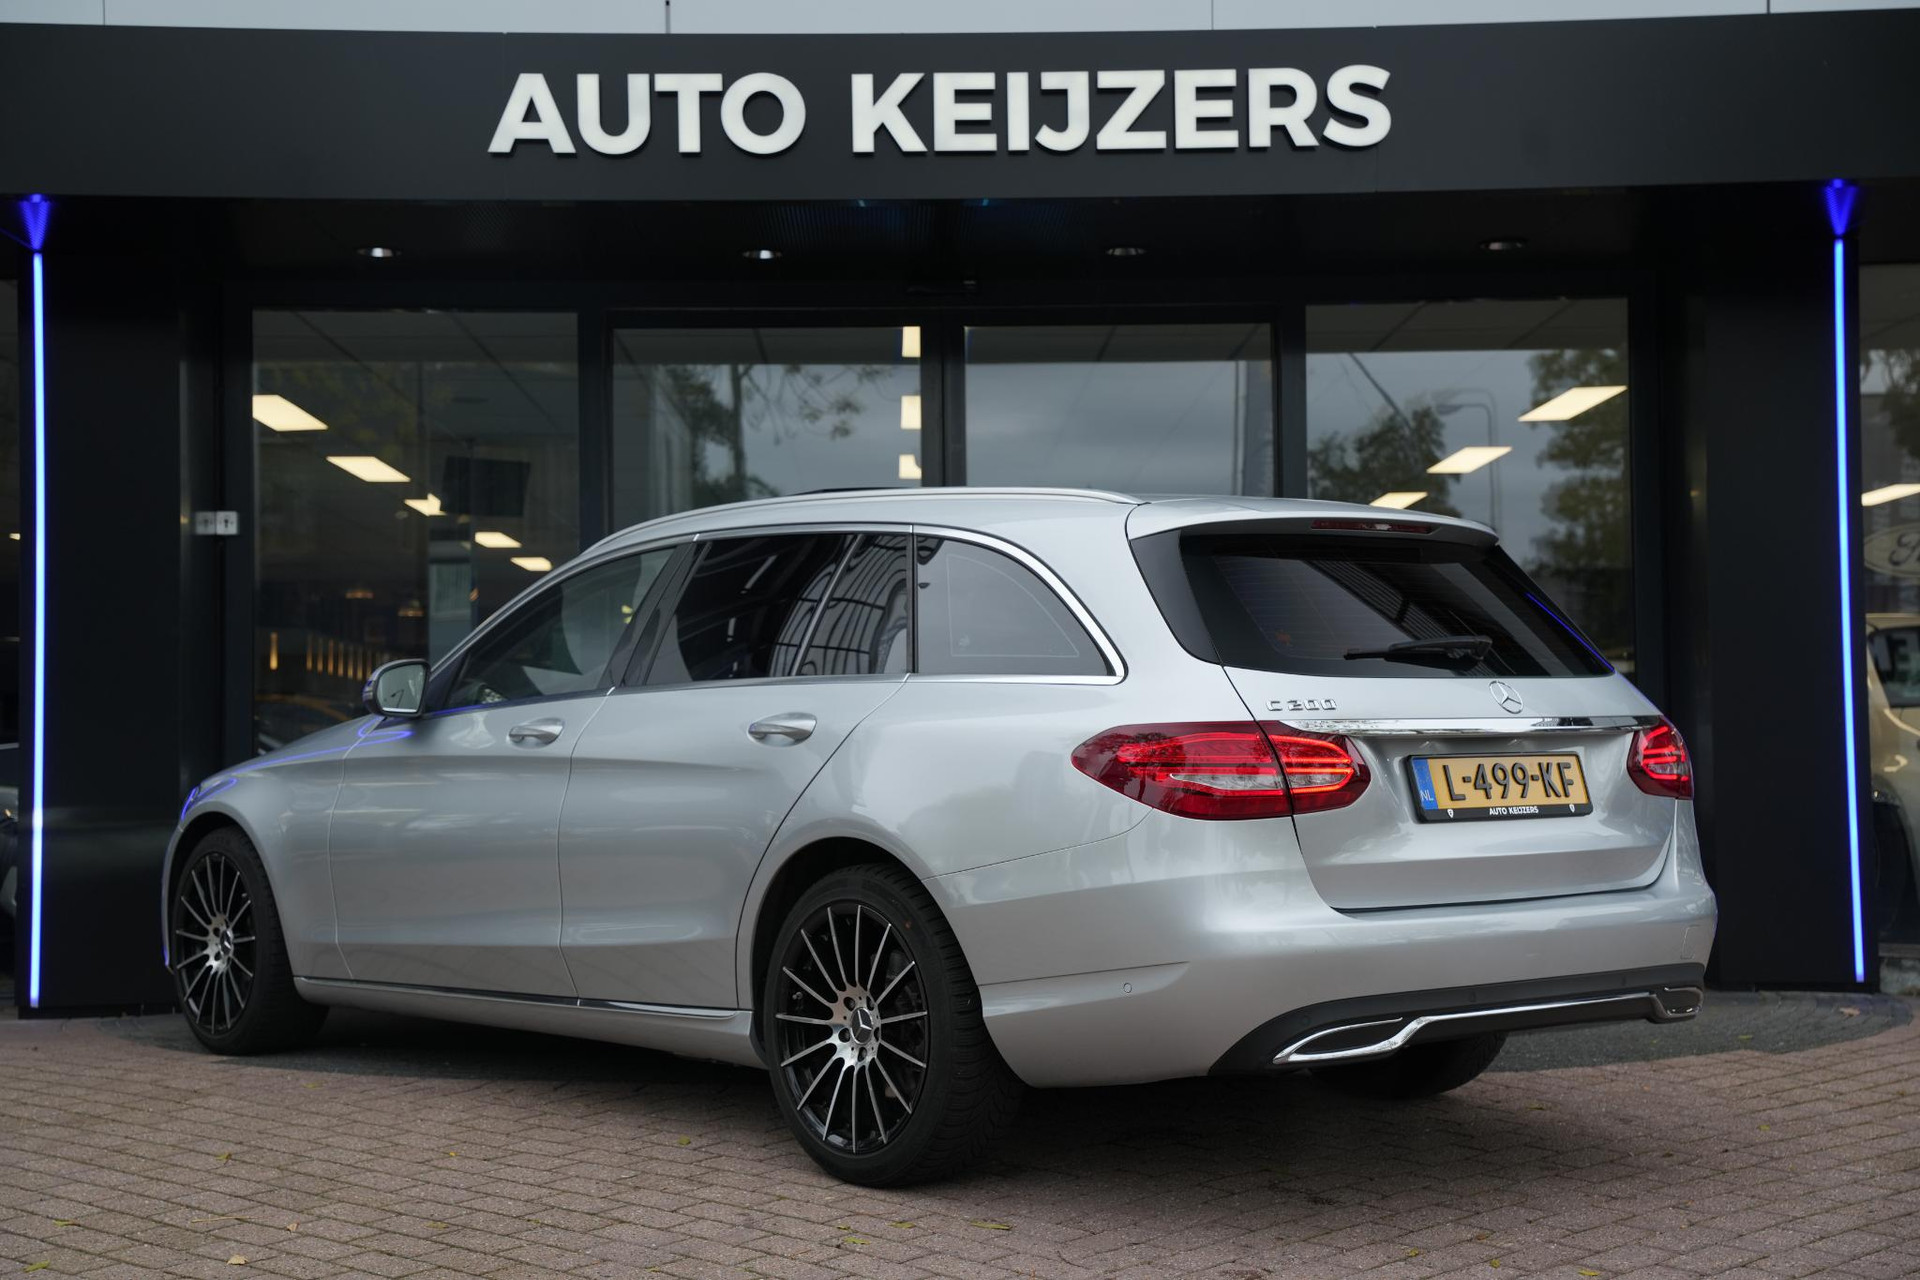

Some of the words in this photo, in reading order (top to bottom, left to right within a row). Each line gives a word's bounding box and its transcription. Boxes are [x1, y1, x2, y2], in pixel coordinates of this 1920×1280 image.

[488, 72, 806, 155] AUTO
[851, 65, 1392, 154] KEIJZERS
[1267, 700, 1284, 712] C
[1289, 699, 1338, 712] 200
[1443, 762, 1575, 801] L-499-KF
[1420, 790, 1435, 801] NL
[1489, 806, 1507, 815] AUTO
[1509, 805, 1539, 815] KEIJZERS
